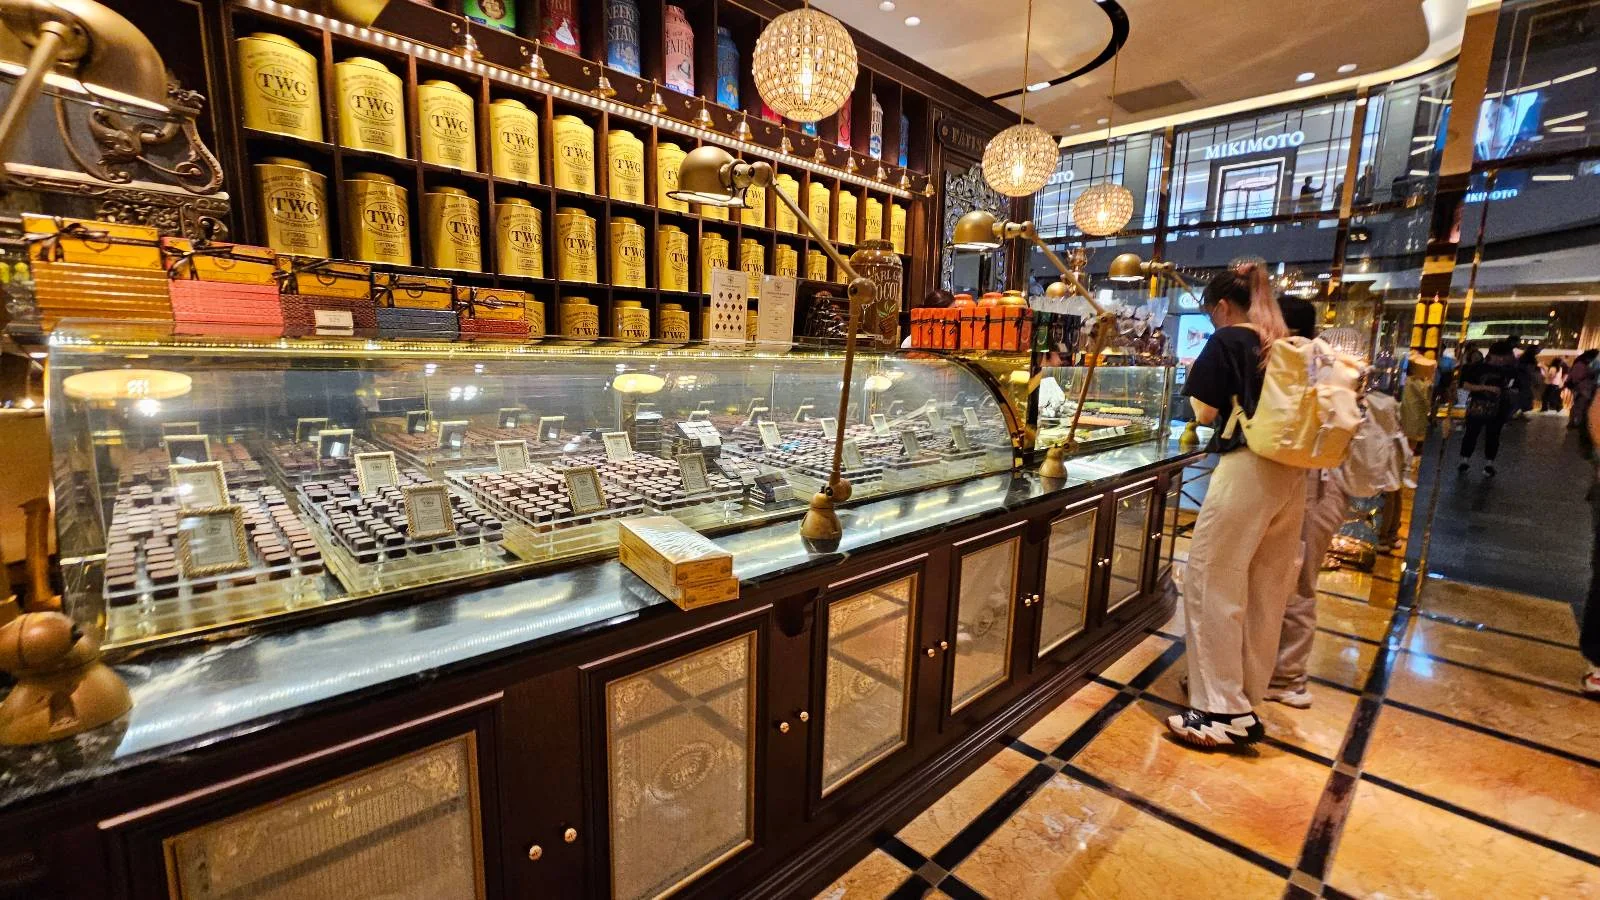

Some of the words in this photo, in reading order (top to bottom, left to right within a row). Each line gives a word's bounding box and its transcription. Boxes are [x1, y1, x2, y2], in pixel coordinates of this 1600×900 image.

[258, 72, 307, 96] TWG
[273, 89, 297, 101] TEA
[351, 95, 394, 116] TWG
[363, 109, 386, 119] TEA
[431, 114, 468, 133] TWG
[443, 128, 461, 137] TEA
[502, 131, 535, 149] TWG
[1204, 130, 1305, 160] MIKIMOTO
[513, 144, 529, 153] TEA
[563, 145, 592, 162] TWG
[614, 158, 641, 173] TWG
[284, 190, 306, 199] 1837
[271, 197, 321, 216] TWG
[286, 212, 309, 221] TEA
[366, 210, 405, 227] TWG
[379, 223, 398, 231] TEA
[450, 221, 480, 237] TWG
[511, 230, 542, 245] TWG
[566, 237, 595, 251] TWG
[622, 246, 645, 259] TWG
[744, 263, 764, 273] TWG
[572, 327, 599, 336] TWG
[624, 329, 648, 338] TWG
[662, 331, 686, 339] TWG
